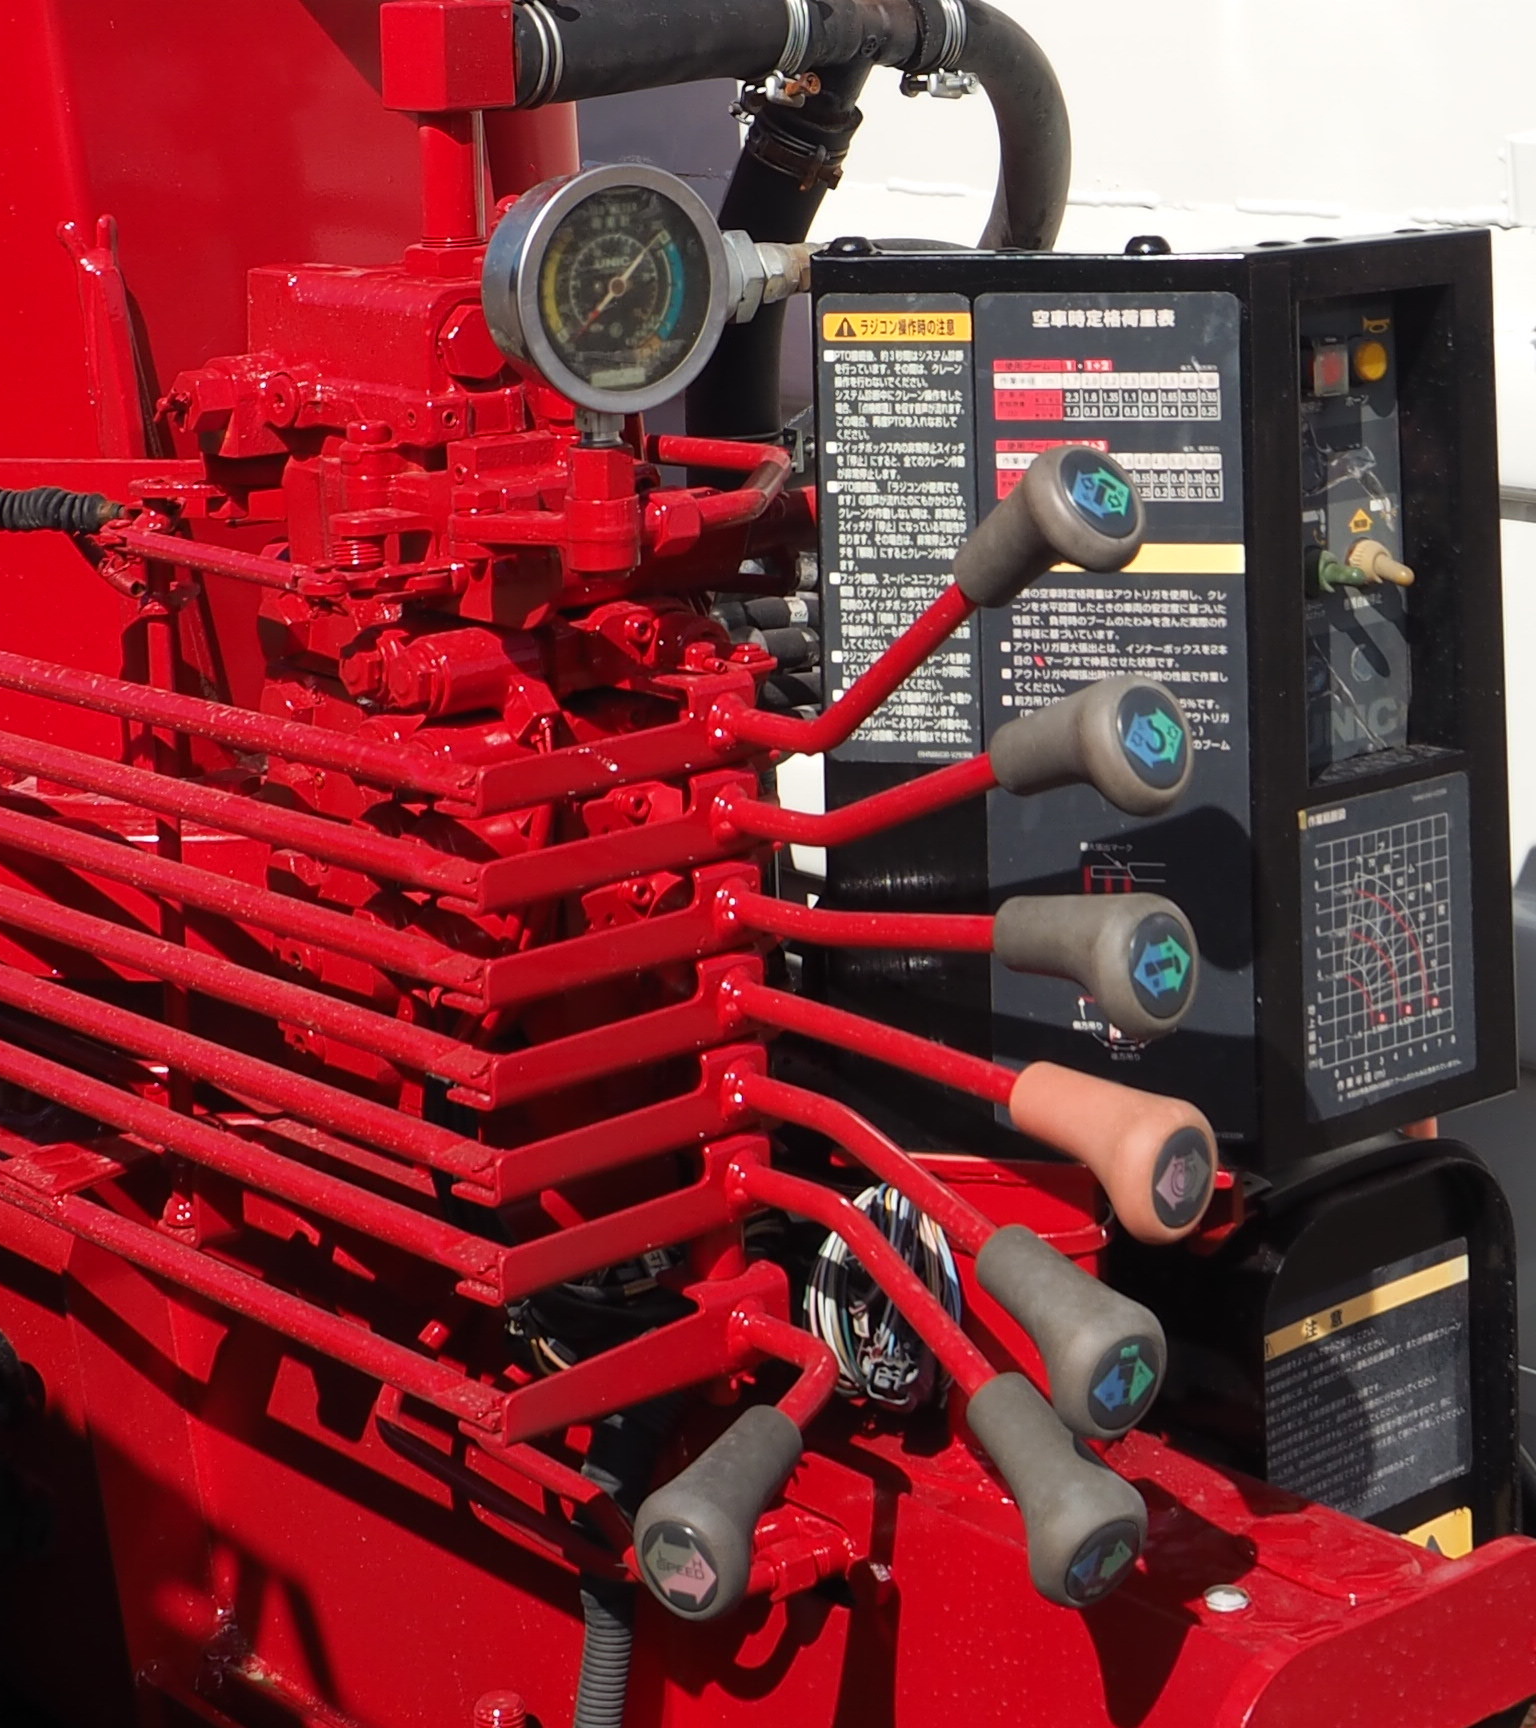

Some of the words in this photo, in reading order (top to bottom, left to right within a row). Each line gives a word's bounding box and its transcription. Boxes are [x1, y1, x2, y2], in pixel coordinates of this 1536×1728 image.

[1032, 309, 1175, 328] 空車時定格荷重表
[860, 318, 955, 336] ラジコン操作時の注意
[1012, 628, 1120, 641] 業半径に基づいています。
[898, 678, 944, 690] てください。
